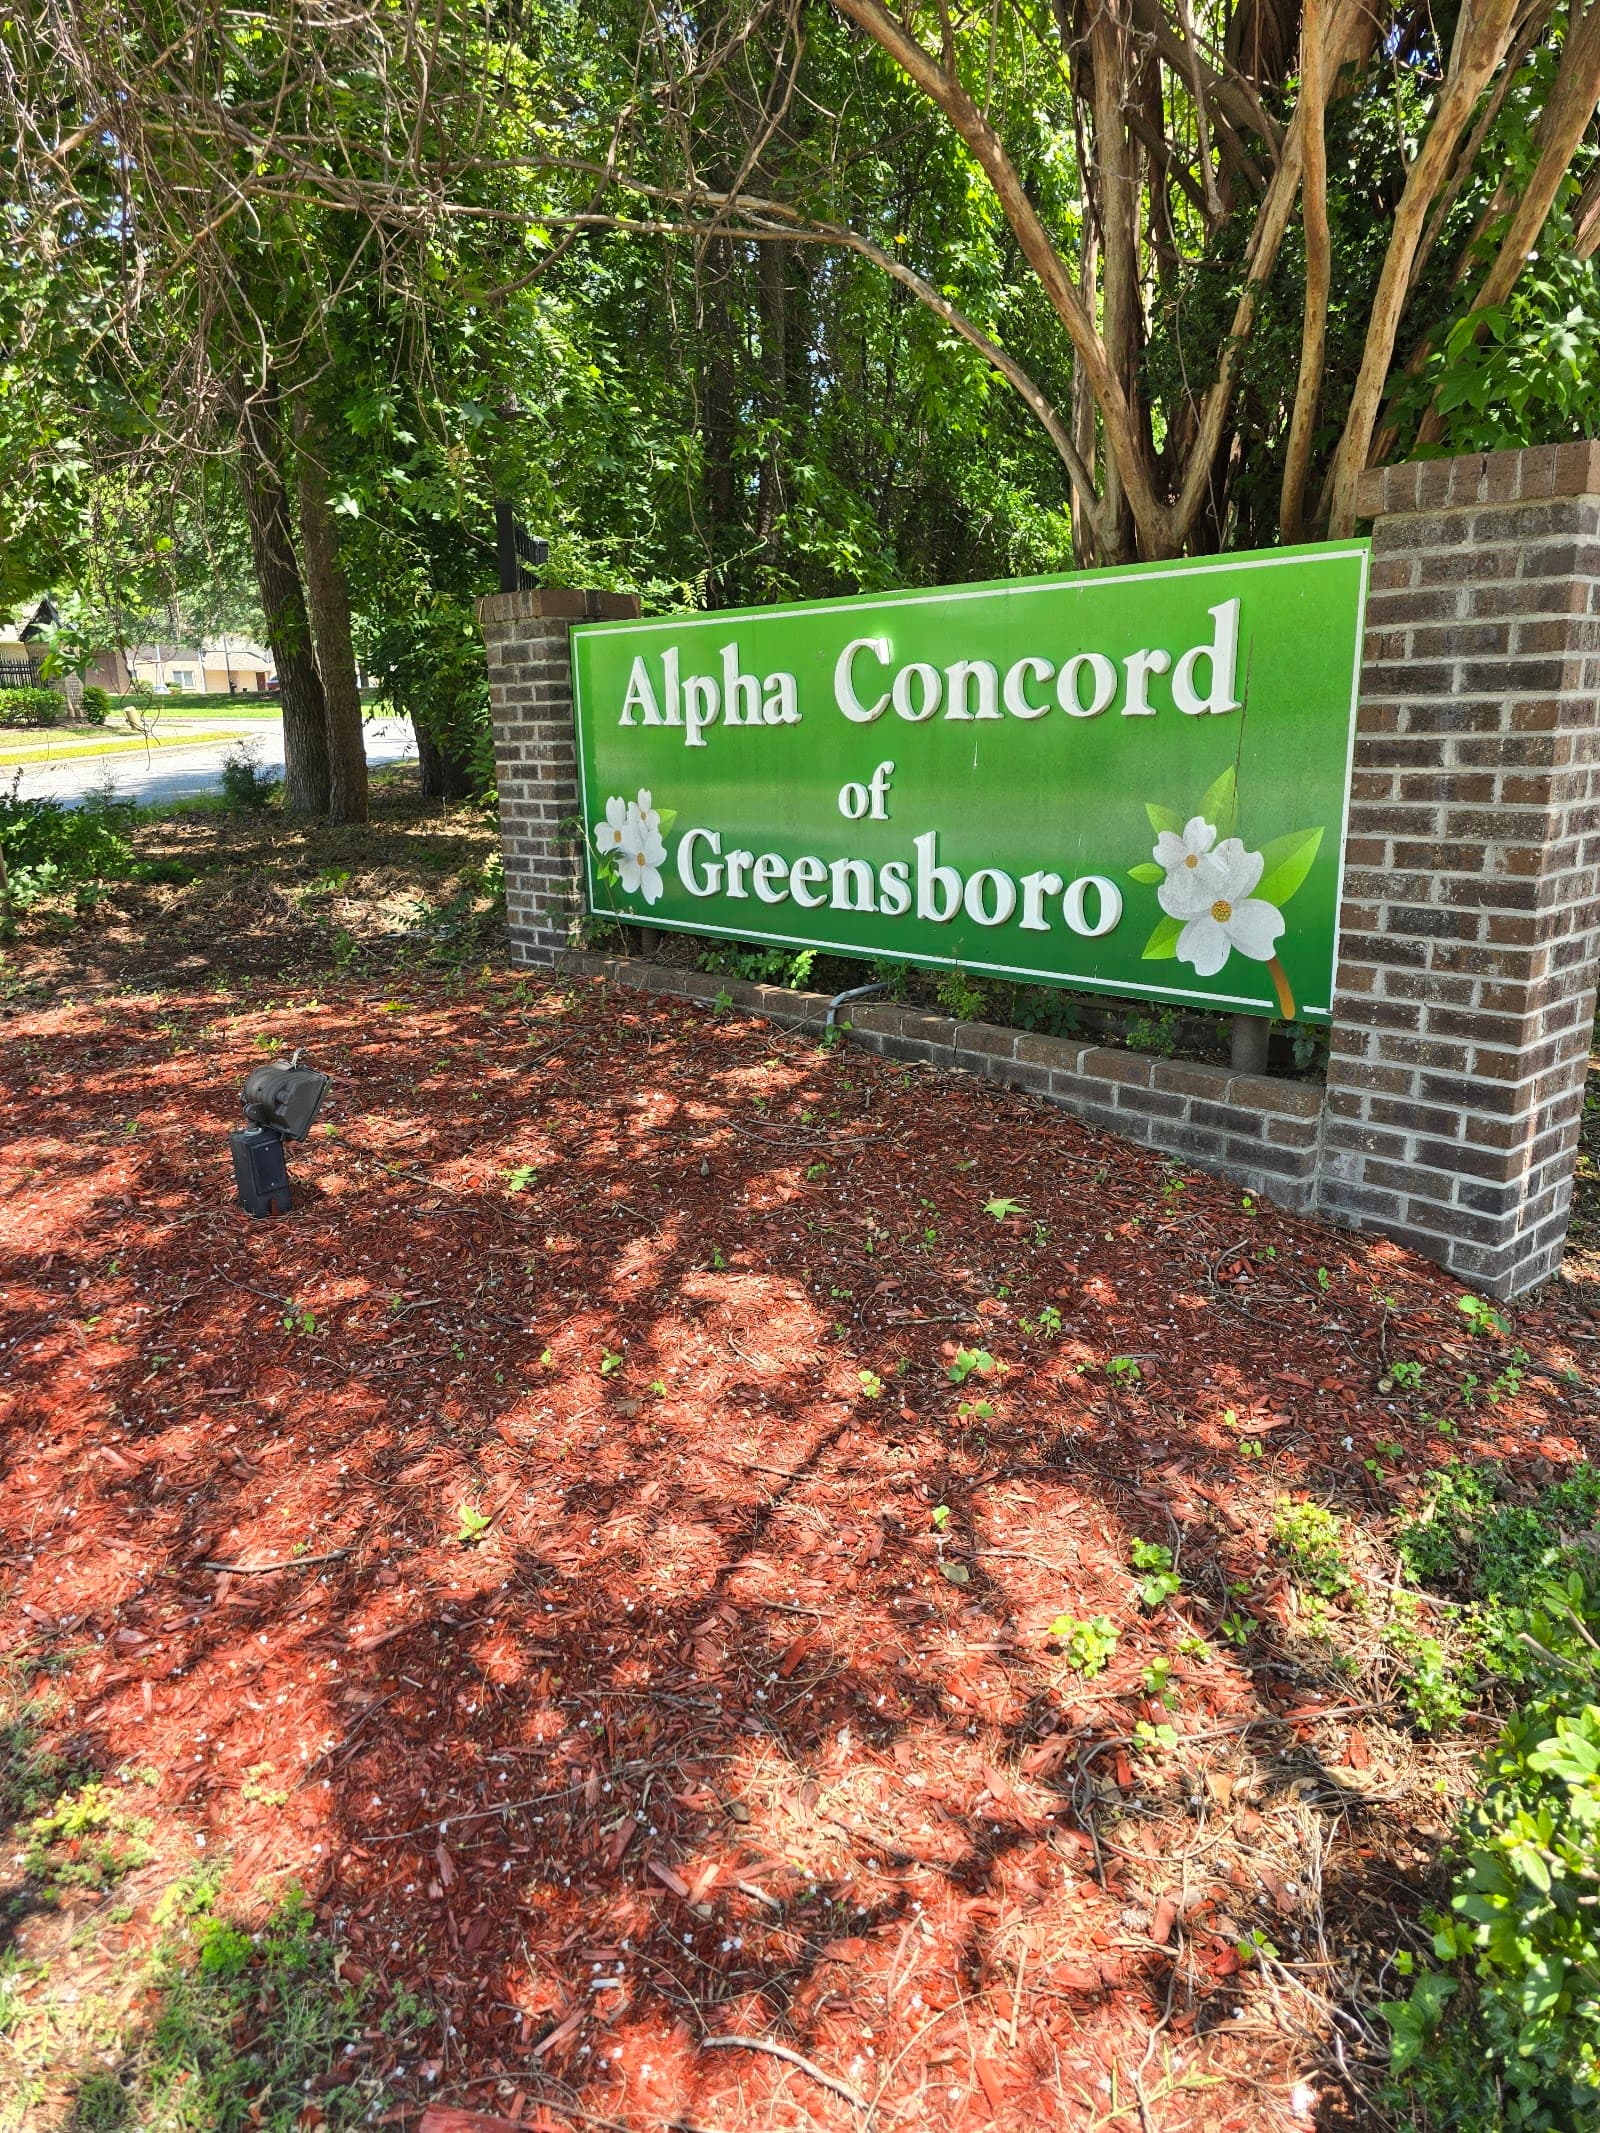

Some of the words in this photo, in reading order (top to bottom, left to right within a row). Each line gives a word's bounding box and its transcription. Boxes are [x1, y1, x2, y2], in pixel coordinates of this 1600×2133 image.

[618, 642, 803, 747] Alpha
[834, 598, 1242, 723] Concord
[838, 761, 895, 820] of
[677, 828, 1124, 937] Greensboro
